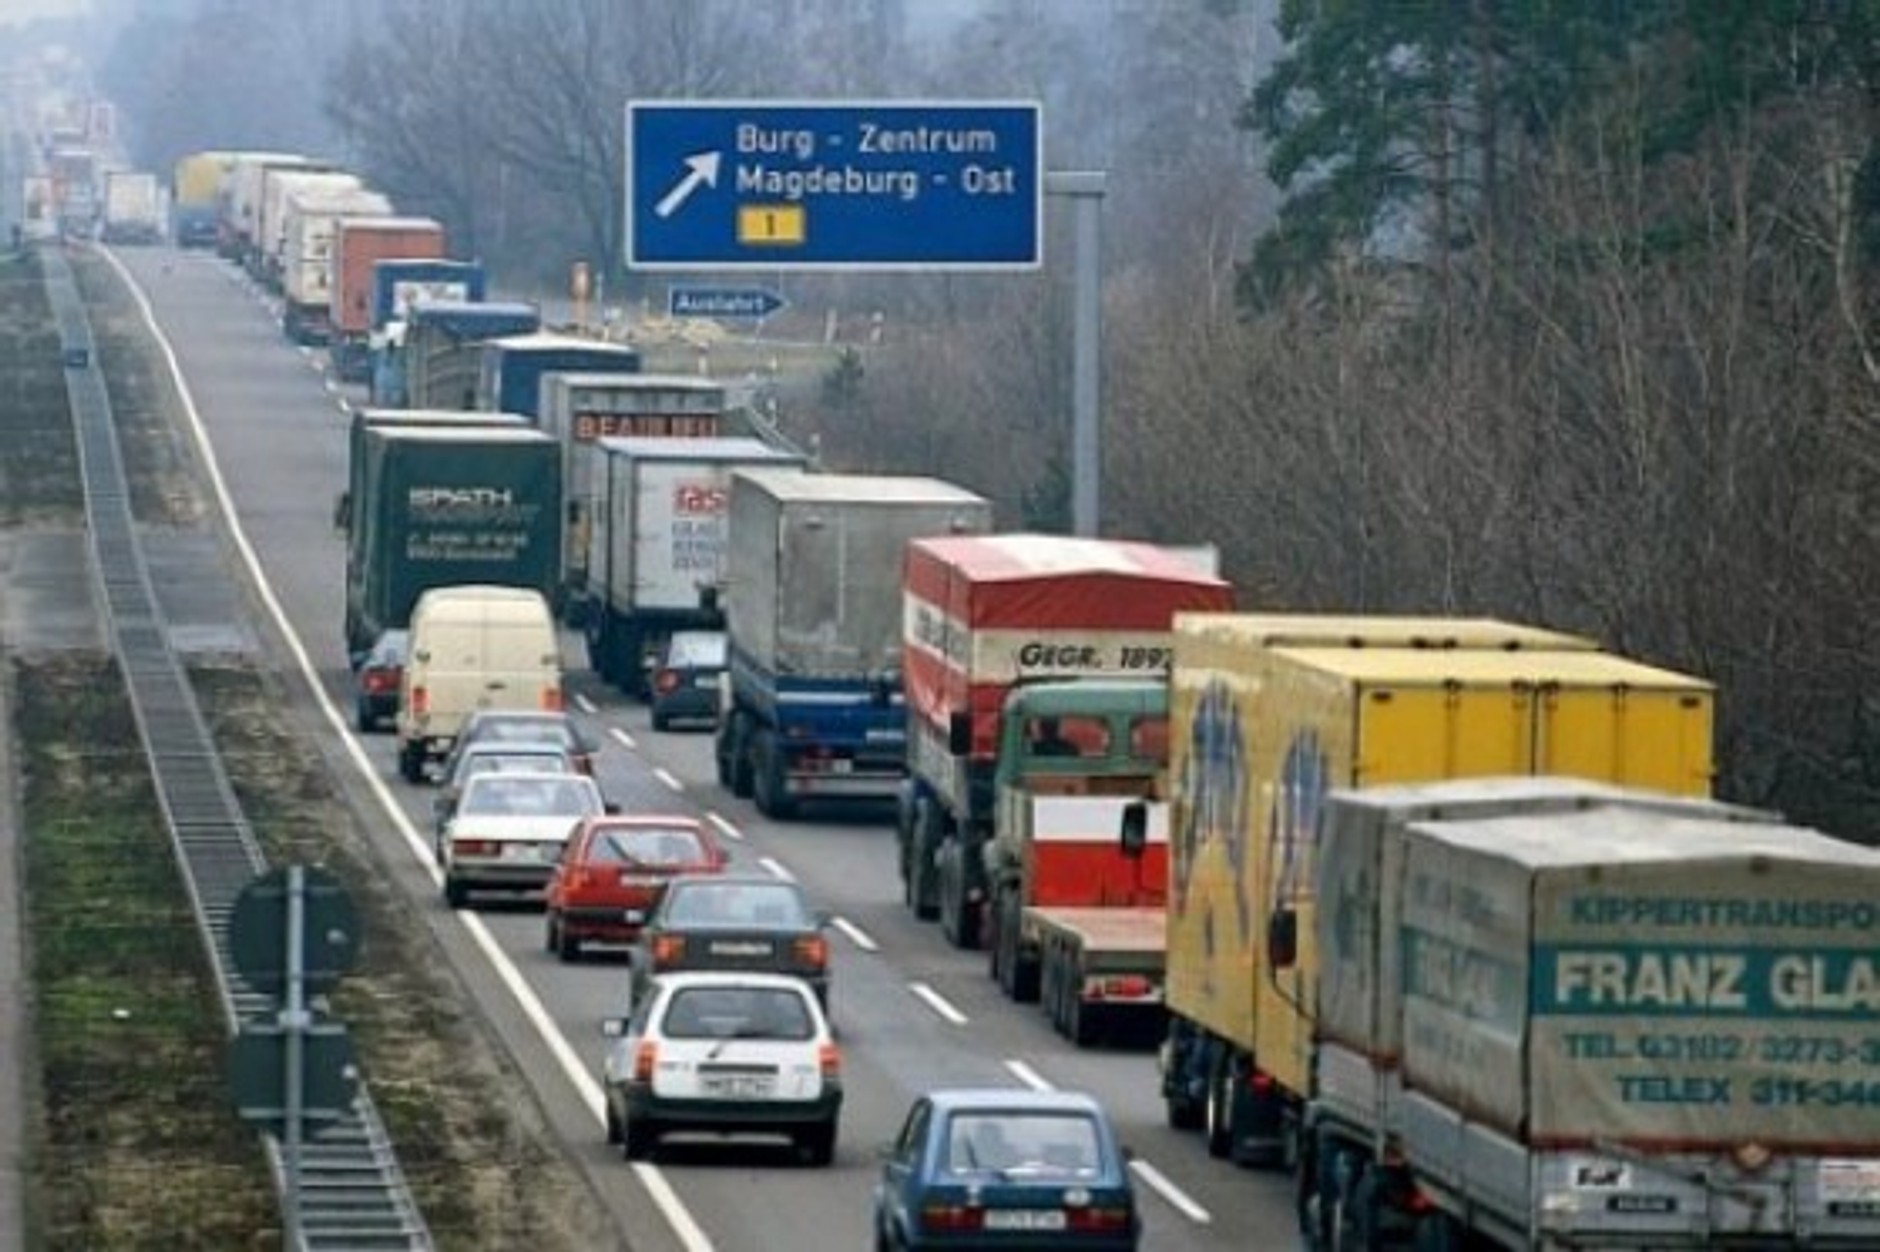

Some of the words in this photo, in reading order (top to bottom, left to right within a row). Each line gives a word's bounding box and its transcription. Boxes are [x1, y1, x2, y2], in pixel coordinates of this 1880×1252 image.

[738, 124, 813, 158] Burg
[859, 125, 996, 154] Zentrum
[737, 165, 918, 199] Magdeburg
[961, 166, 1015, 194] Ost
[1556, 952, 1748, 1007] FRANZ
[1613, 1075, 1731, 1104] TELEX
